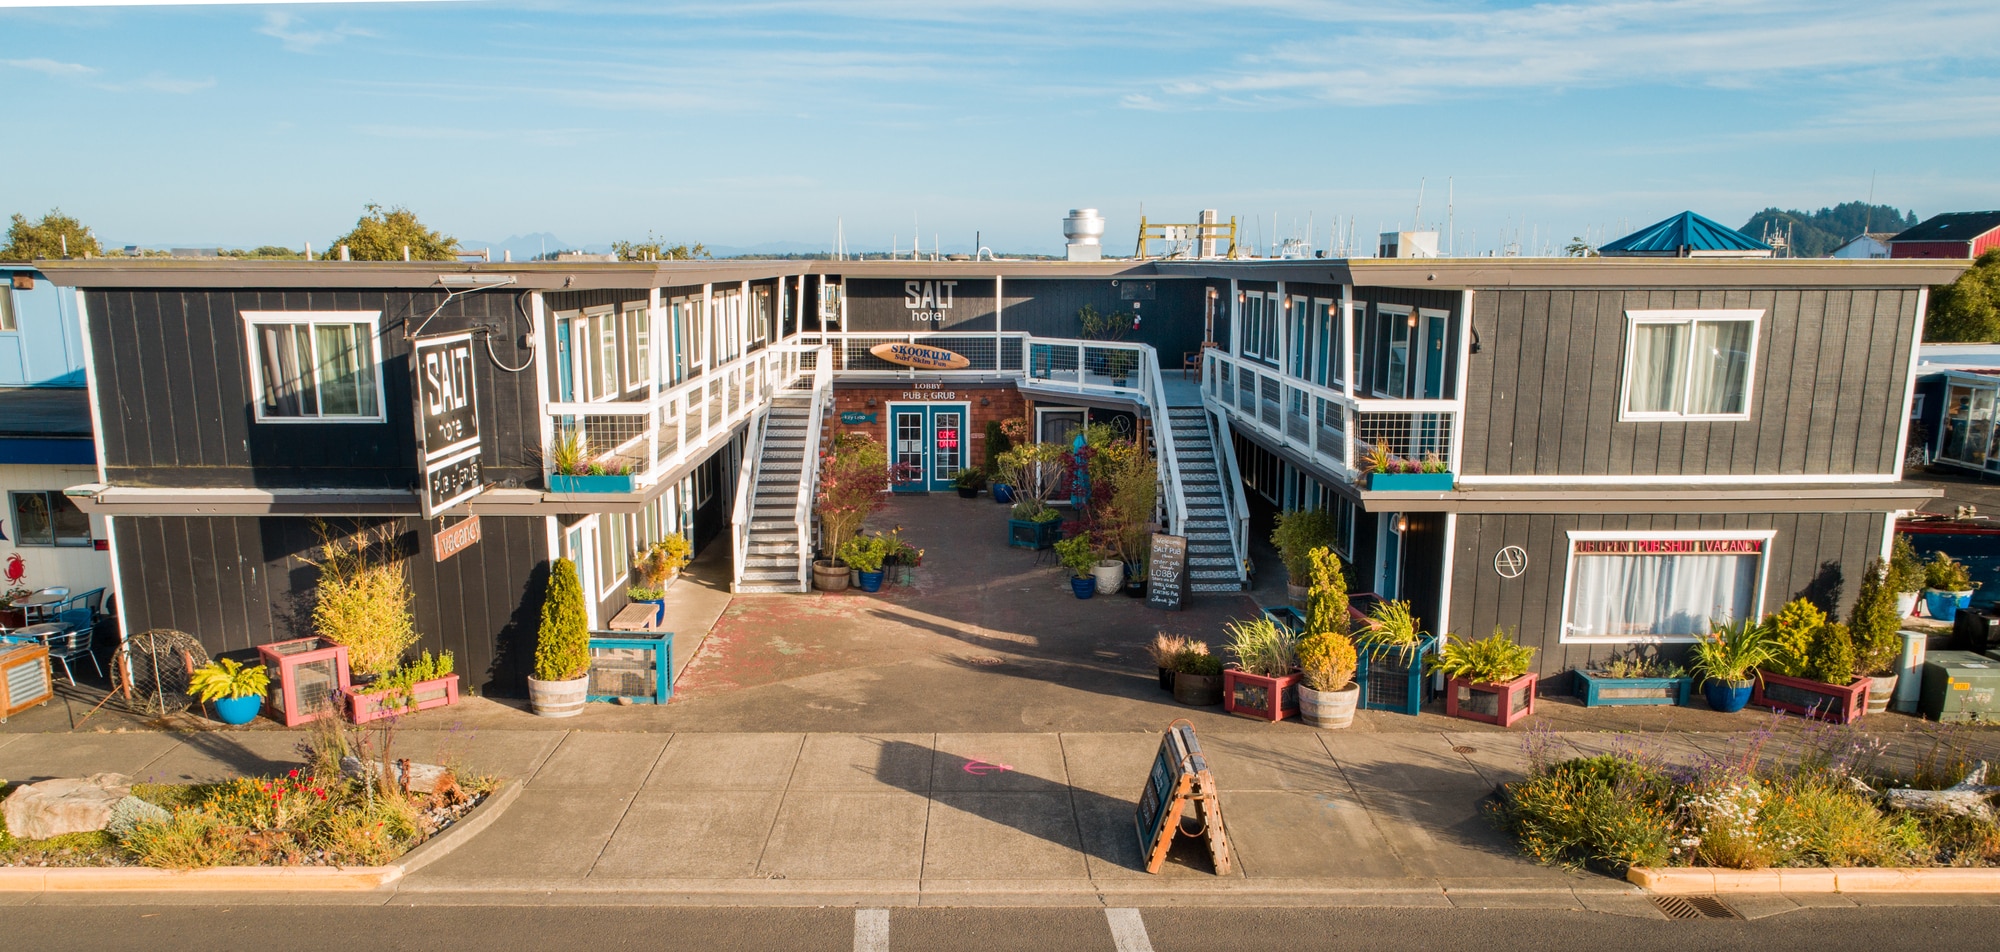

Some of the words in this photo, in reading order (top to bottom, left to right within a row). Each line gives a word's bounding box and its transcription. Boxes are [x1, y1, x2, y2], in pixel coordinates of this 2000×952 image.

[905, 280, 958, 309] SALT
[911, 309, 946, 321] hotel
[891, 344, 952, 361] SKOOKUM
[894, 353, 911, 362] Surf
[913, 357, 931, 365] Skim
[933, 359, 947, 367] Fun
[426, 347, 468, 416] SALT
[902, 391, 921, 399] PUB
[931, 391, 956, 400] GRUB
[938, 430, 956, 439] COME
[434, 475, 450, 495] PB
[441, 519, 481, 555] vacancy
[1156, 537, 1181, 546] Welcome
[1153, 544, 1167, 552] SALT
[1575, 540, 1595, 553] PUB
[1599, 540, 1629, 553] OPEN
[1638, 540, 1661, 553] PUB
[1664, 540, 1693, 553] SHUT
[1705, 540, 1761, 553] VACANCY
[1151, 569, 1179, 580] LOBBY
